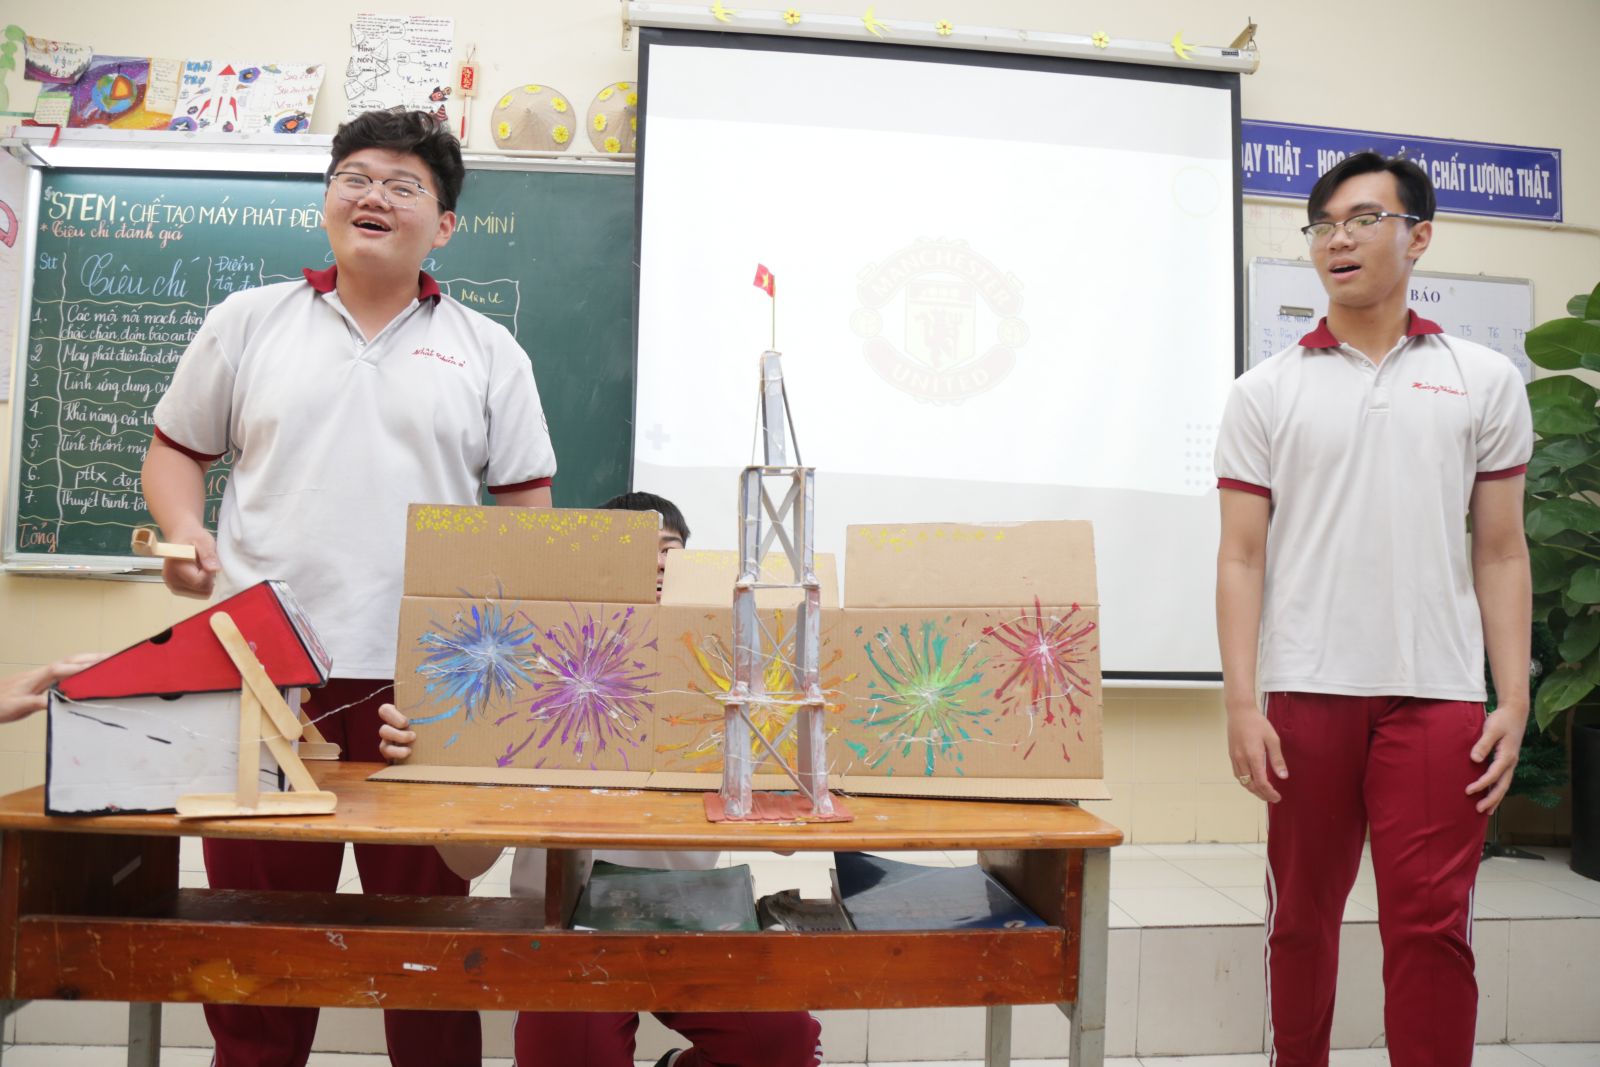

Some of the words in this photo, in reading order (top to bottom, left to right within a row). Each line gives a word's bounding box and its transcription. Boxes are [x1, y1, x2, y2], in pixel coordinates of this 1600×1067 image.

[1241, 142, 1262, 178] ẠY
[1266, 140, 1301, 182] THẬT
[1431, 152, 1466, 192] CHẤT
[1469, 162, 1514, 200] LƯỢNG
[1516, 164, 1552, 205] THẬT.
[129, 194, 164, 223] CHẾ
[198, 195, 239, 225] MÁY
[242, 199, 287, 226] PHÁT
[215, 256, 255, 272] Điểm
[871, 248, 1009, 306] MANCHESTER
[1410, 286, 1441, 303] BÁO
[67, 304, 91, 322] Các
[62, 343, 89, 370] Máy
[155, 376, 170, 393] củ
[892, 364, 990, 392] UNITED
